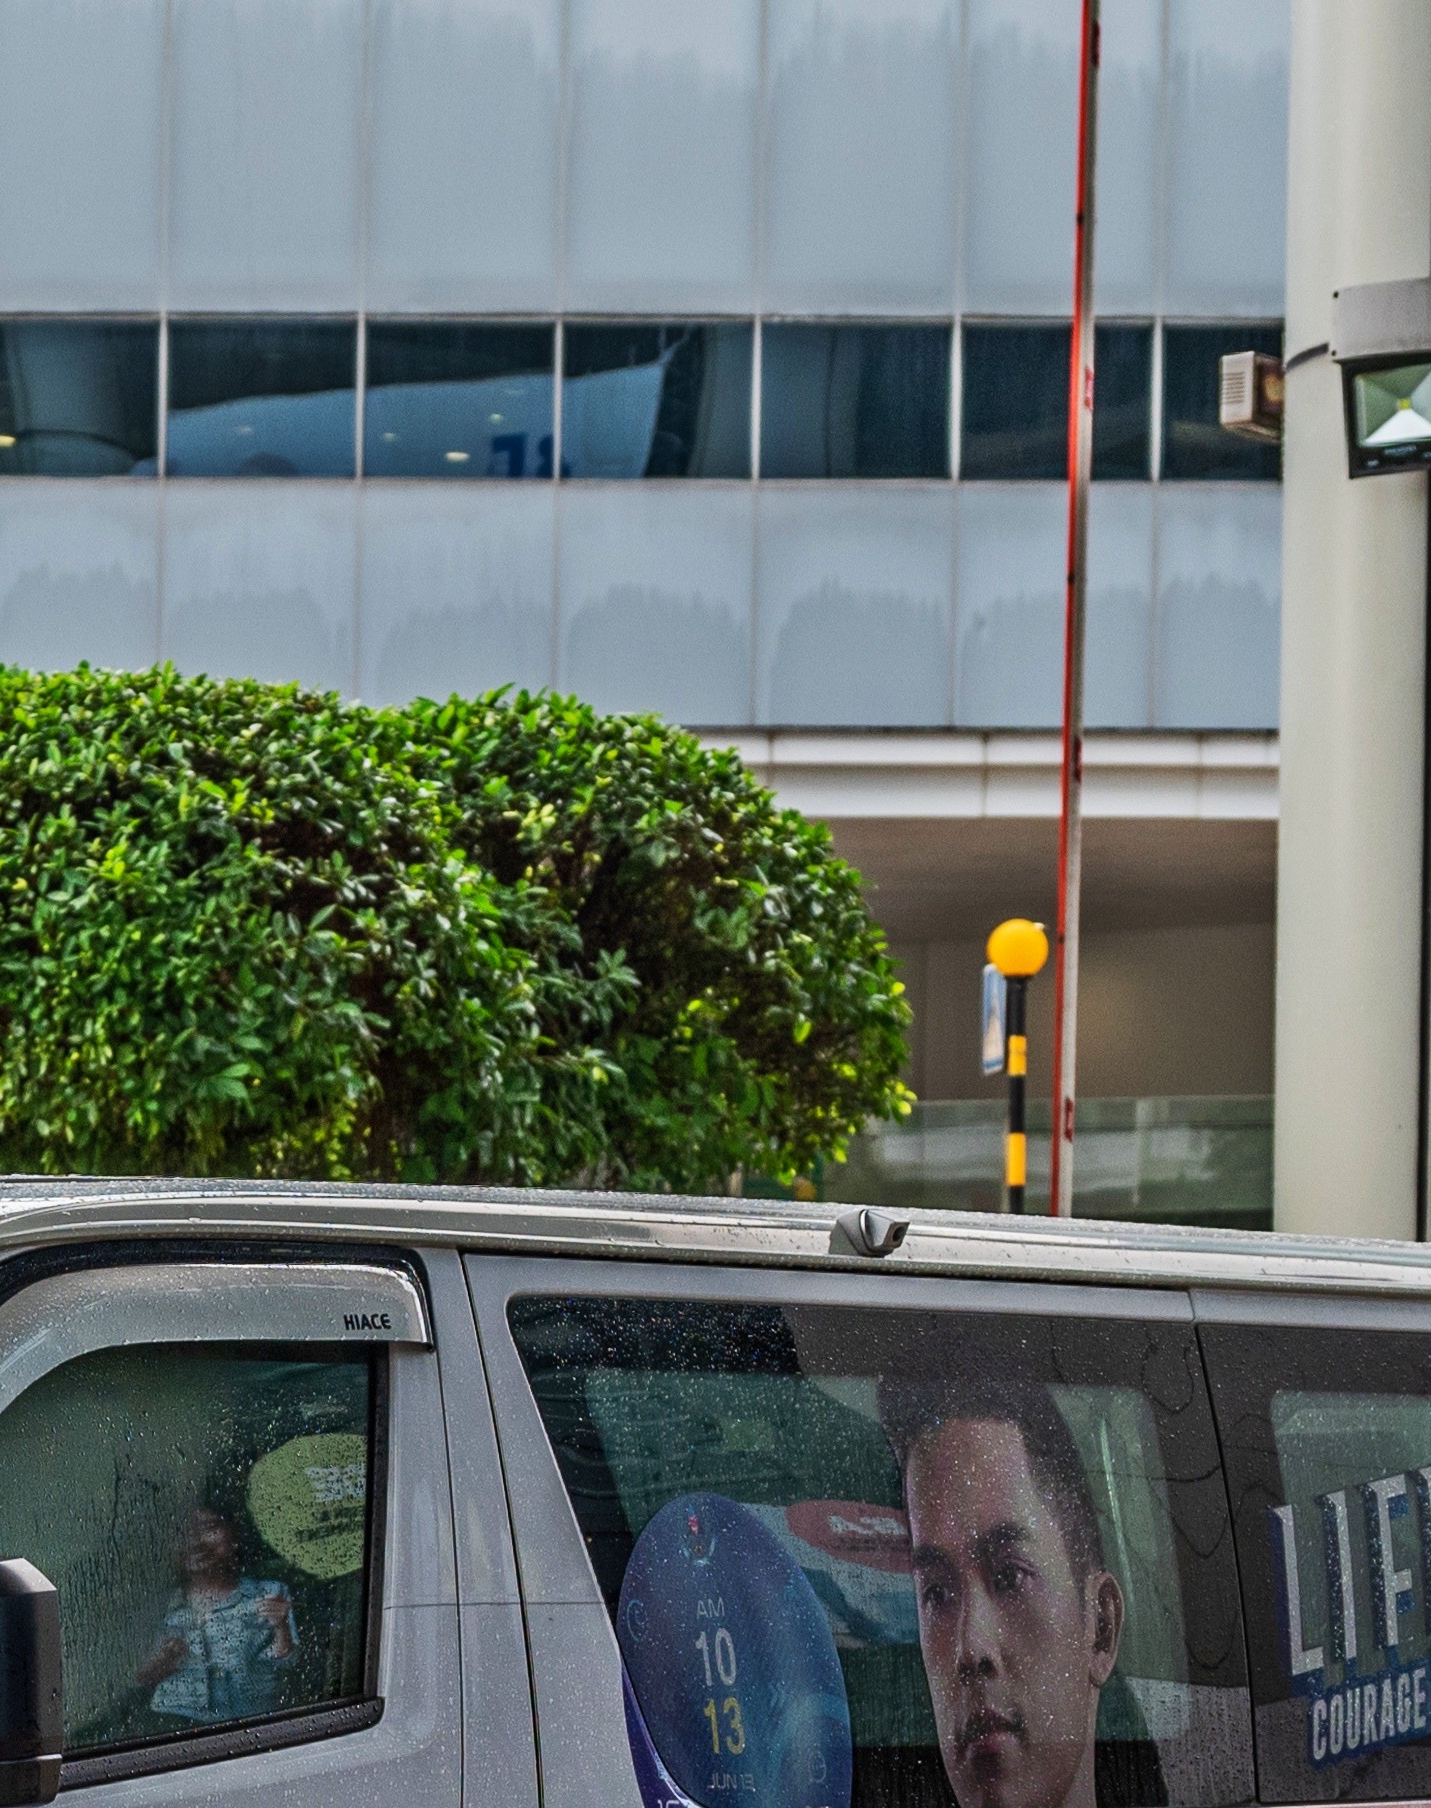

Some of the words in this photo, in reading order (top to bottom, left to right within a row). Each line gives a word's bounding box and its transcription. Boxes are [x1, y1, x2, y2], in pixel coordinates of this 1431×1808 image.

[343, 1313, 392, 1331] HIACE
[696, 1598, 726, 1618] AM
[695, 1628, 737, 1687] 10
[703, 1697, 746, 1755] 13
[1309, 1664, 1429, 1763] COURAGE
[707, 1772, 738, 1790] JUN
